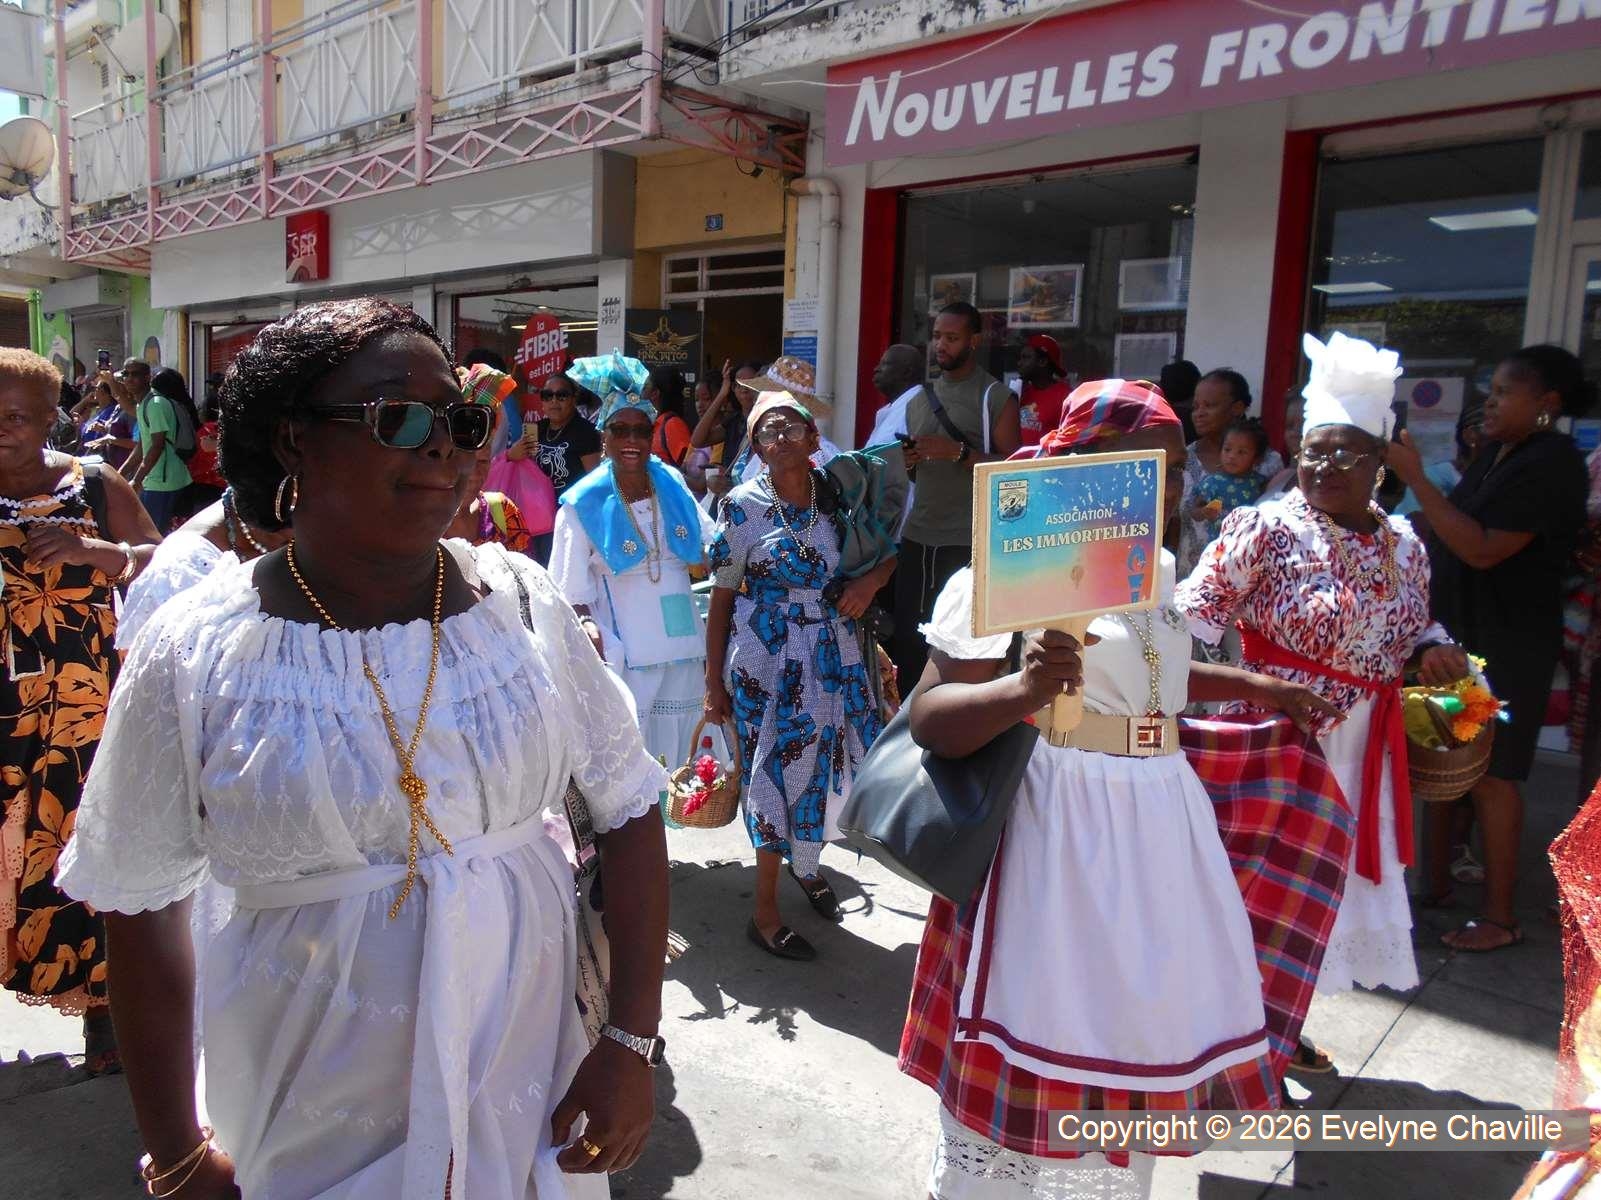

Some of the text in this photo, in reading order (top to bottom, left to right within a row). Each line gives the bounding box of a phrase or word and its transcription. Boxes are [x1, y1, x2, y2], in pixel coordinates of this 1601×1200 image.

[844, 44, 1178, 146] NOUVELLES
[524, 325, 569, 363] FIBRE
[529, 366, 541, 379] est
[1002, 522, 1150, 554] LES IMMORTELLES
